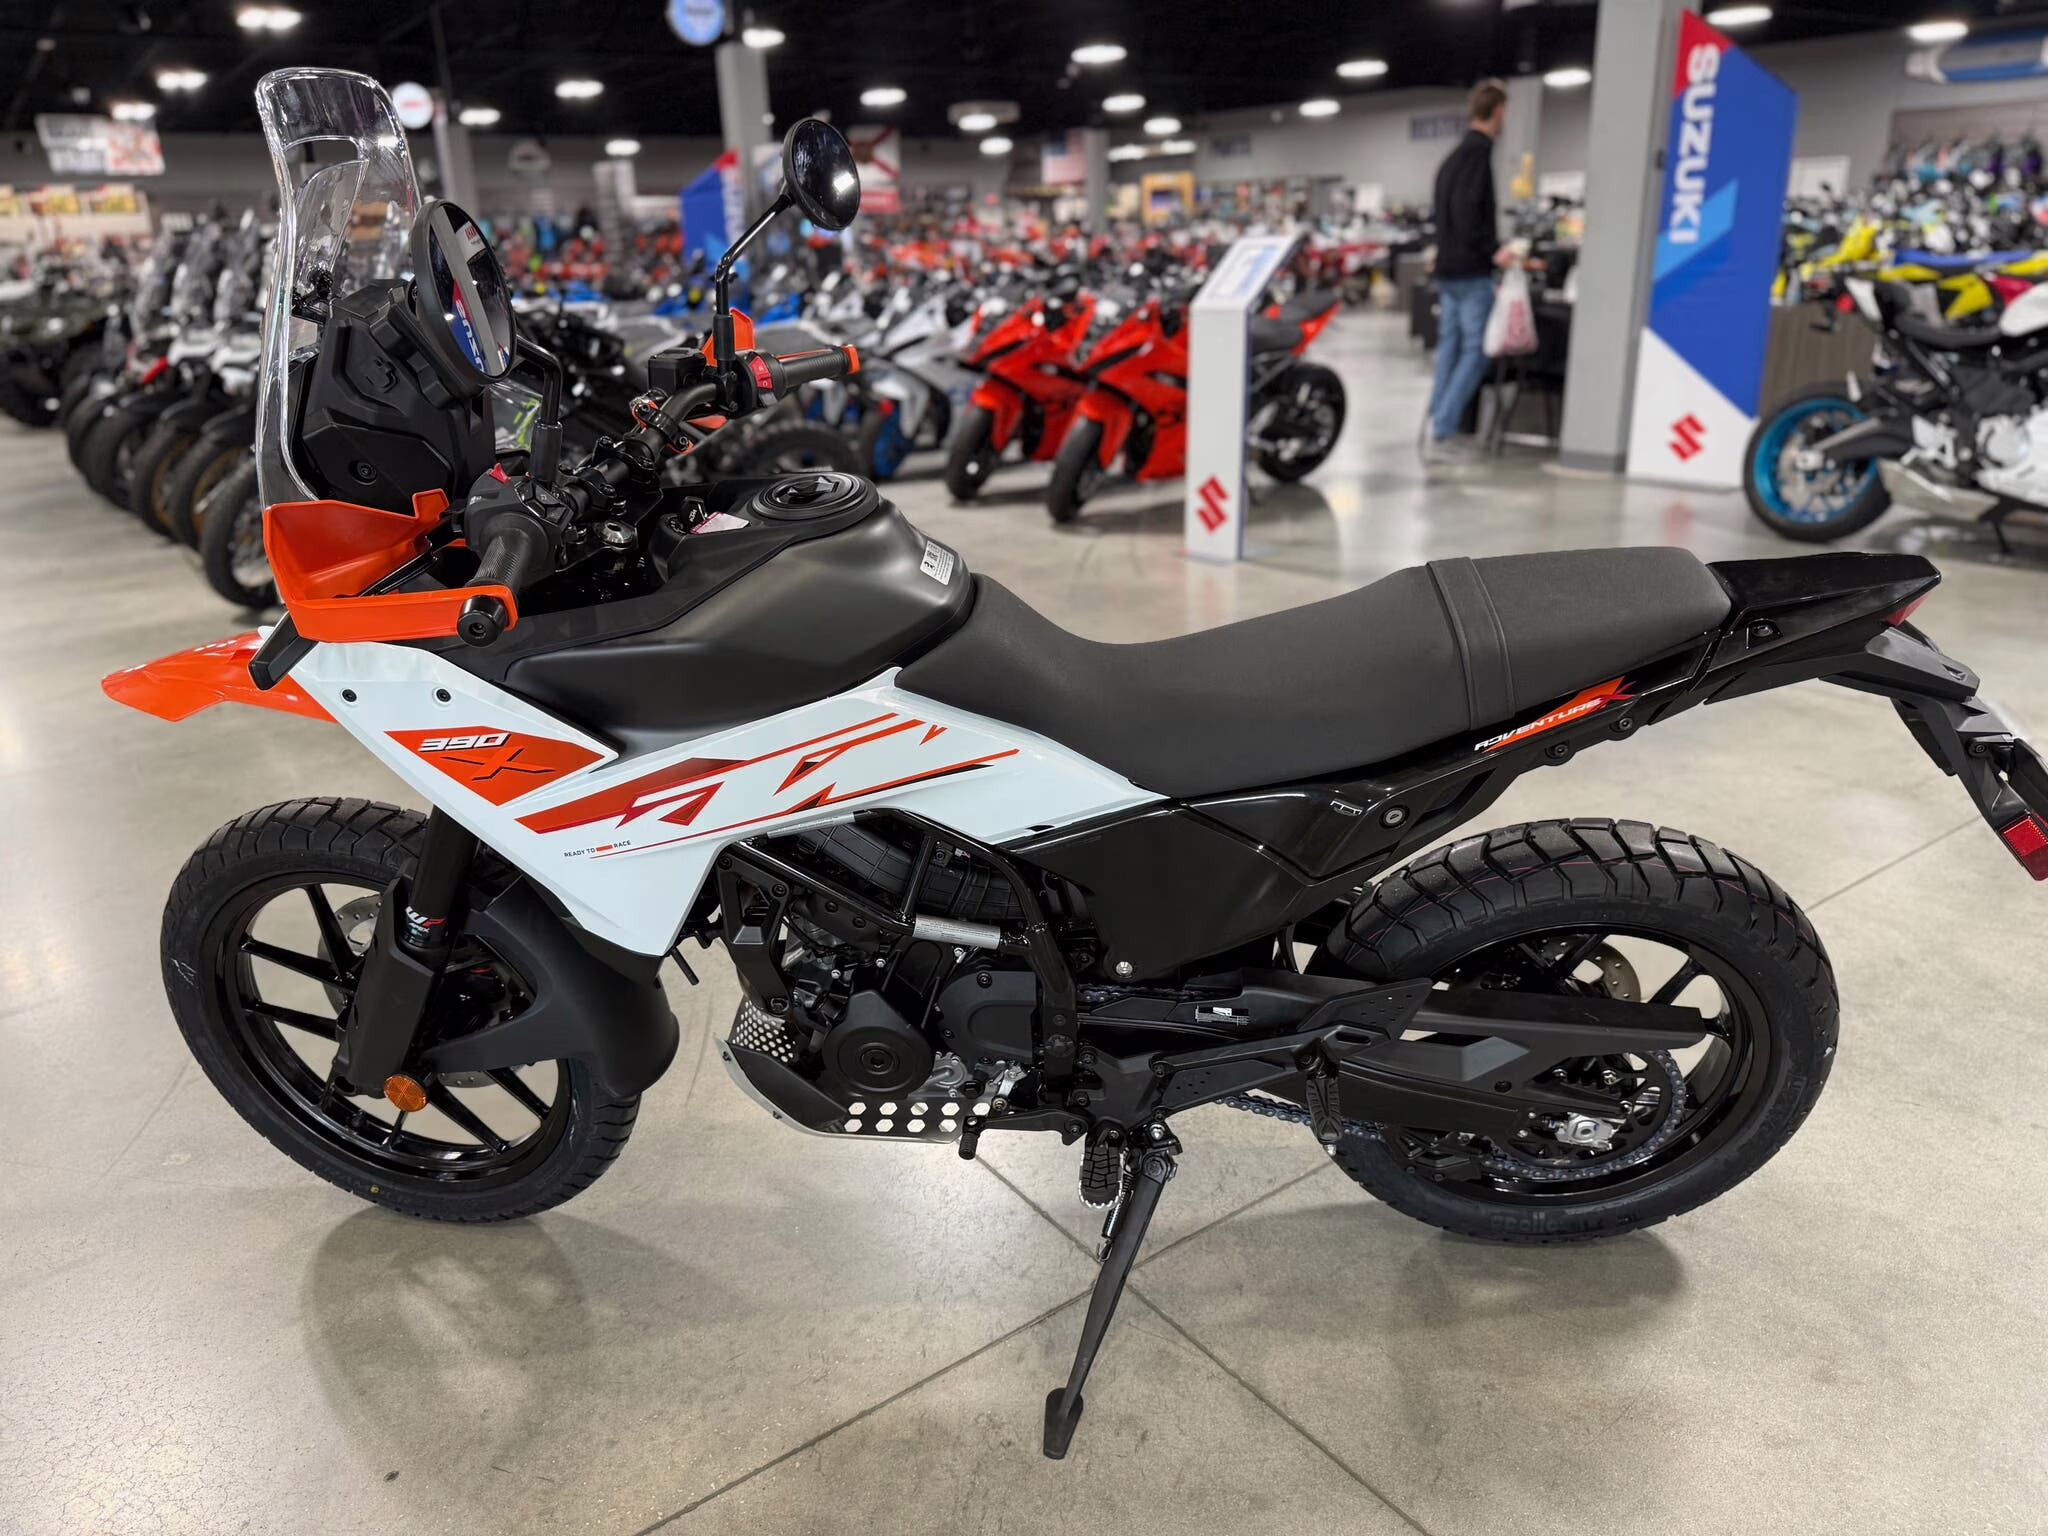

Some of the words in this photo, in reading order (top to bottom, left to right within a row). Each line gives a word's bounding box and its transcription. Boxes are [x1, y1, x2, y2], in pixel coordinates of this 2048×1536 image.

[1669, 42, 1721, 245] SUZUKI
[418, 732, 511, 752] 390
[1474, 697, 1603, 752] ADVENTURE
[564, 849, 585, 857] READY
[613, 840, 632, 848] RACE
